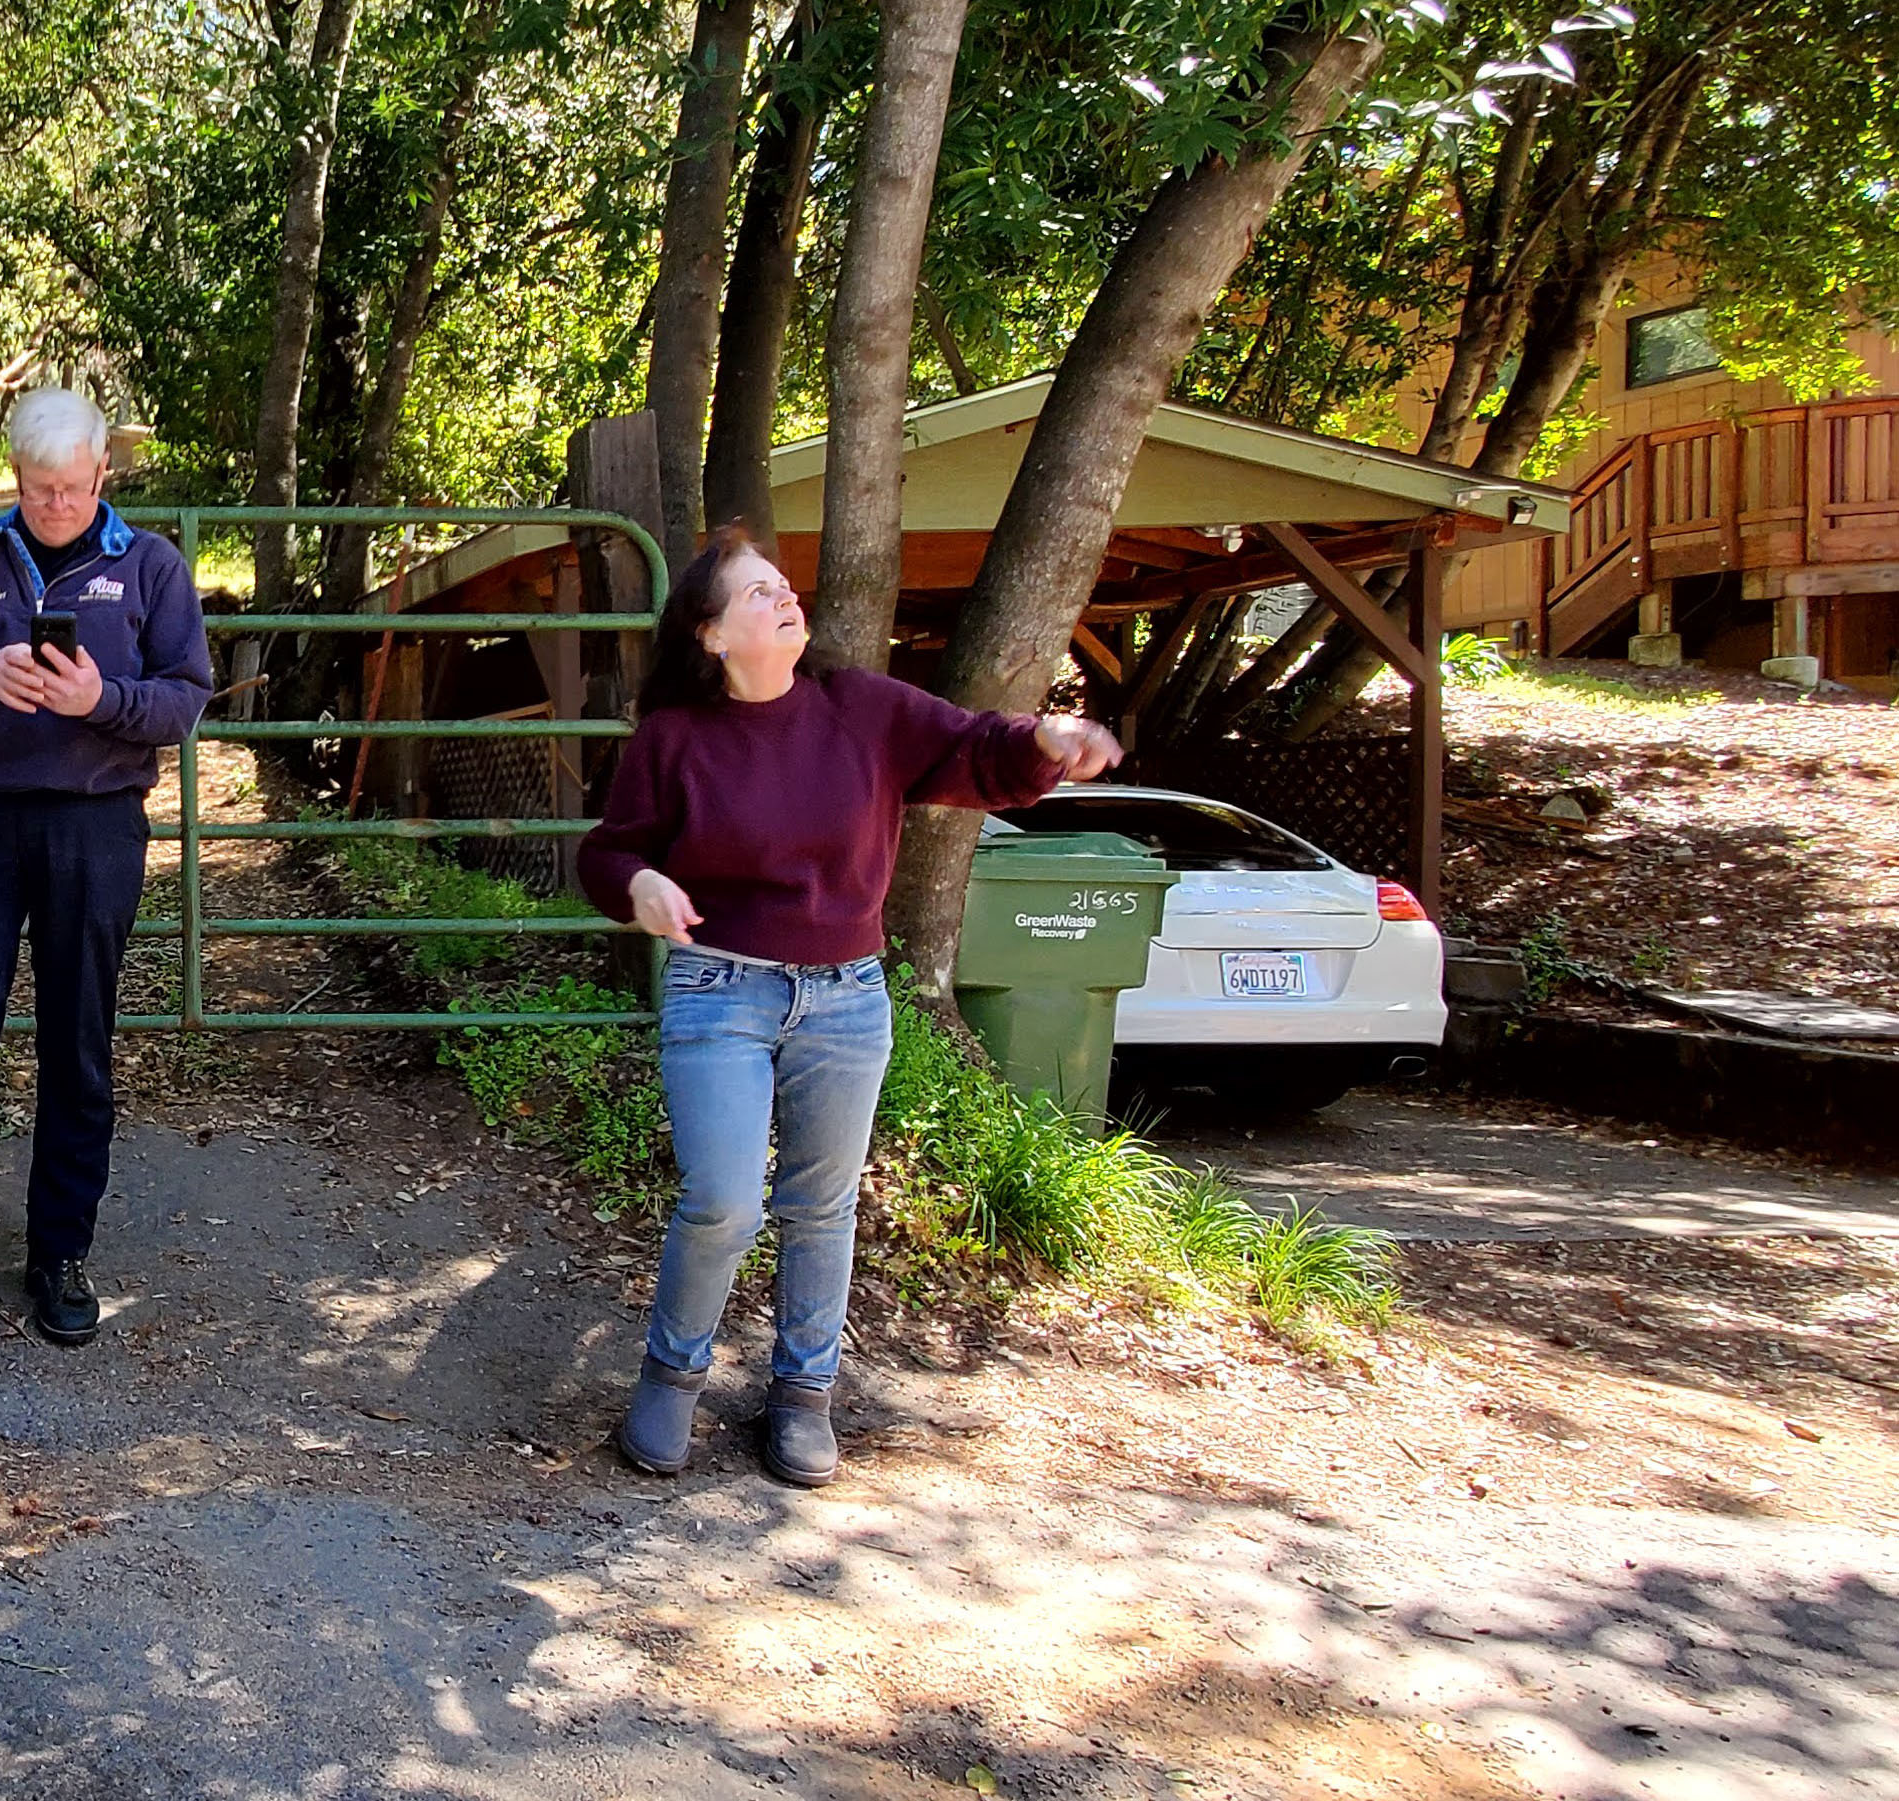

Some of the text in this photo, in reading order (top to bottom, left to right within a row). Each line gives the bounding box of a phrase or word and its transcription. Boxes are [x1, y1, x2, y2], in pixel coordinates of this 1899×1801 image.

[1015, 913, 1097, 928] GreenWaste
[1031, 928, 1075, 940] Recovery
[1230, 968, 1299, 989] 6WDT197
